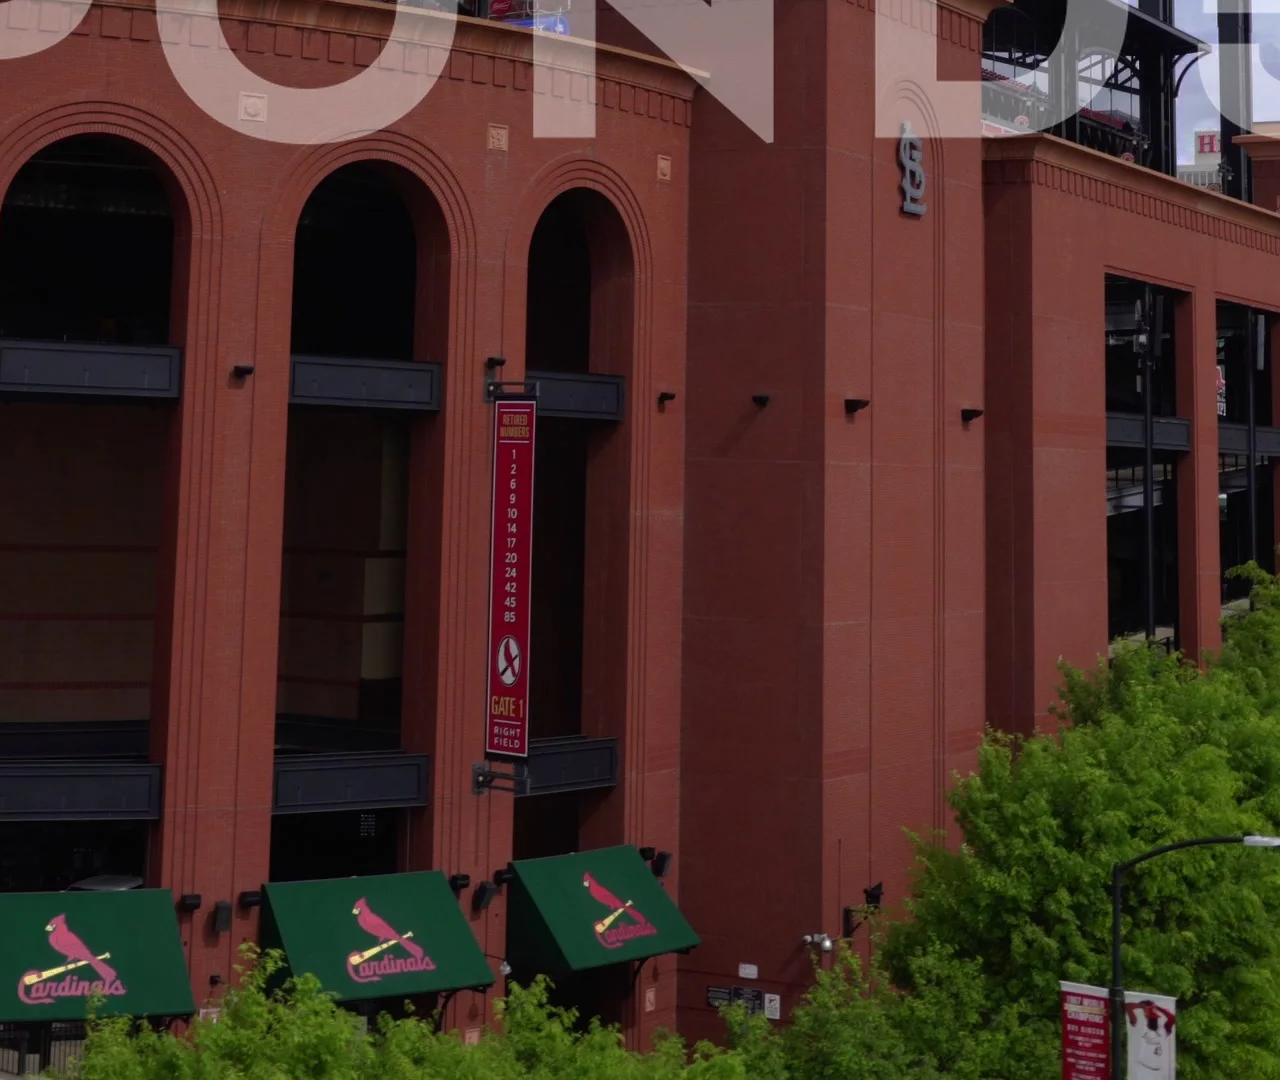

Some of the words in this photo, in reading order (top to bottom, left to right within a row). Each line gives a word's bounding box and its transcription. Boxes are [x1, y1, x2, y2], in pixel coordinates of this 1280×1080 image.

[502, 414, 528, 426] RETIRED
[500, 426, 530, 438] NUMBERS
[511, 449, 516, 460] 1
[510, 463, 517, 475] 2
[510, 478, 517, 490] 6
[509, 493, 516, 504] 9
[507, 508, 518, 519] 10
[506, 522, 517, 534] 14
[506, 537, 517, 549] 17
[504, 552, 518, 563] 20
[504, 567, 517, 578] 24
[504, 581, 517, 593] 42
[504, 596, 517, 608] 45
[503, 611, 516, 623] 85
[491, 695, 516, 717] GATE
[519, 698, 524, 718] 1
[493, 726, 521, 738] RIGHT
[493, 737, 520, 748] FIELD
[593, 918, 658, 950] Cardinals
[346, 950, 437, 983] Cardinals
[17, 969, 128, 1004] Cardinals
